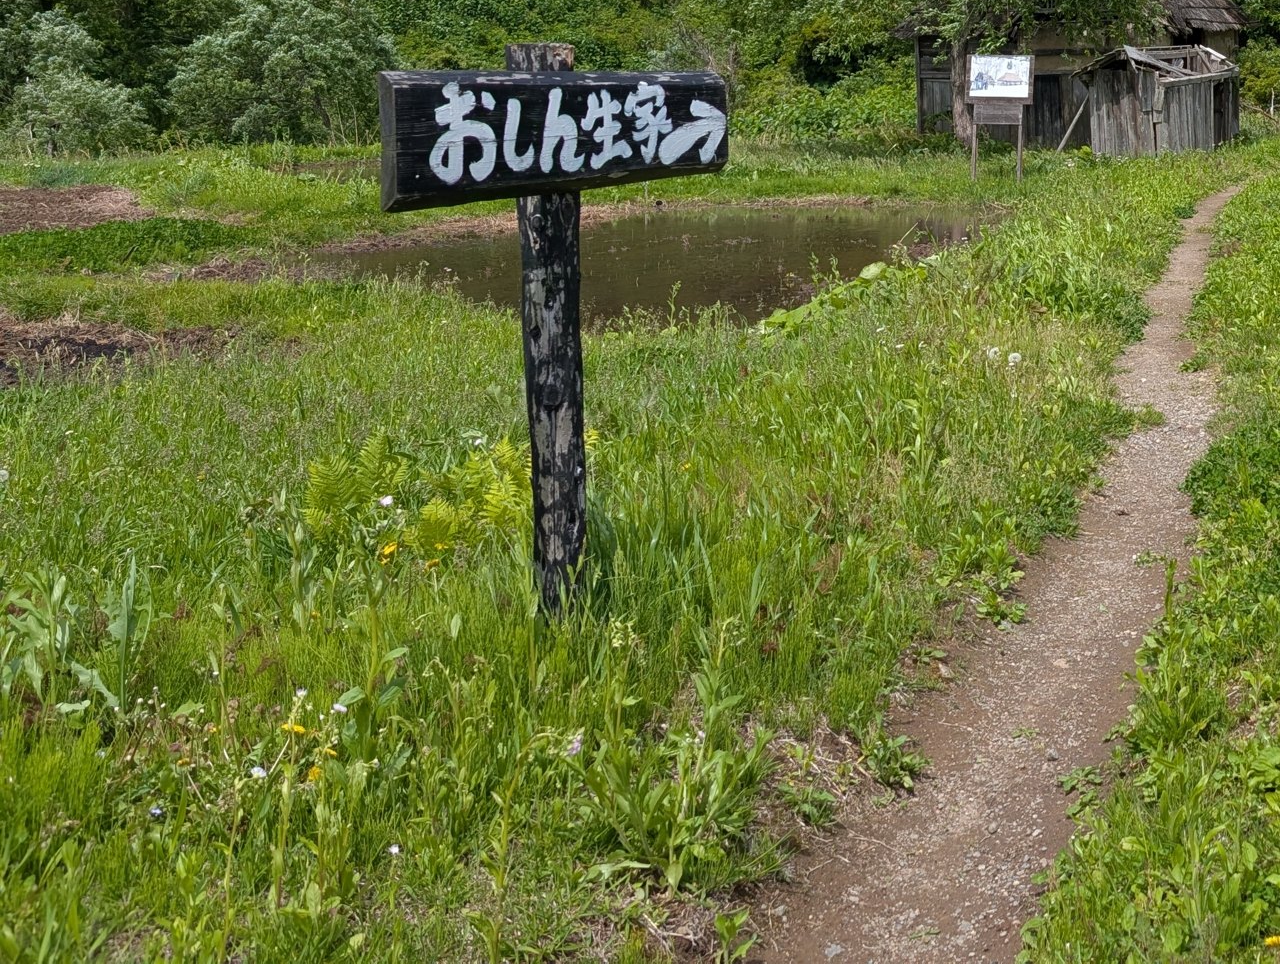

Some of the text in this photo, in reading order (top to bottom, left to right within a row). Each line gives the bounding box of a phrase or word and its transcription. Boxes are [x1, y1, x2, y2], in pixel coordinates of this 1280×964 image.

[428, 80, 674, 185] おしん生家
